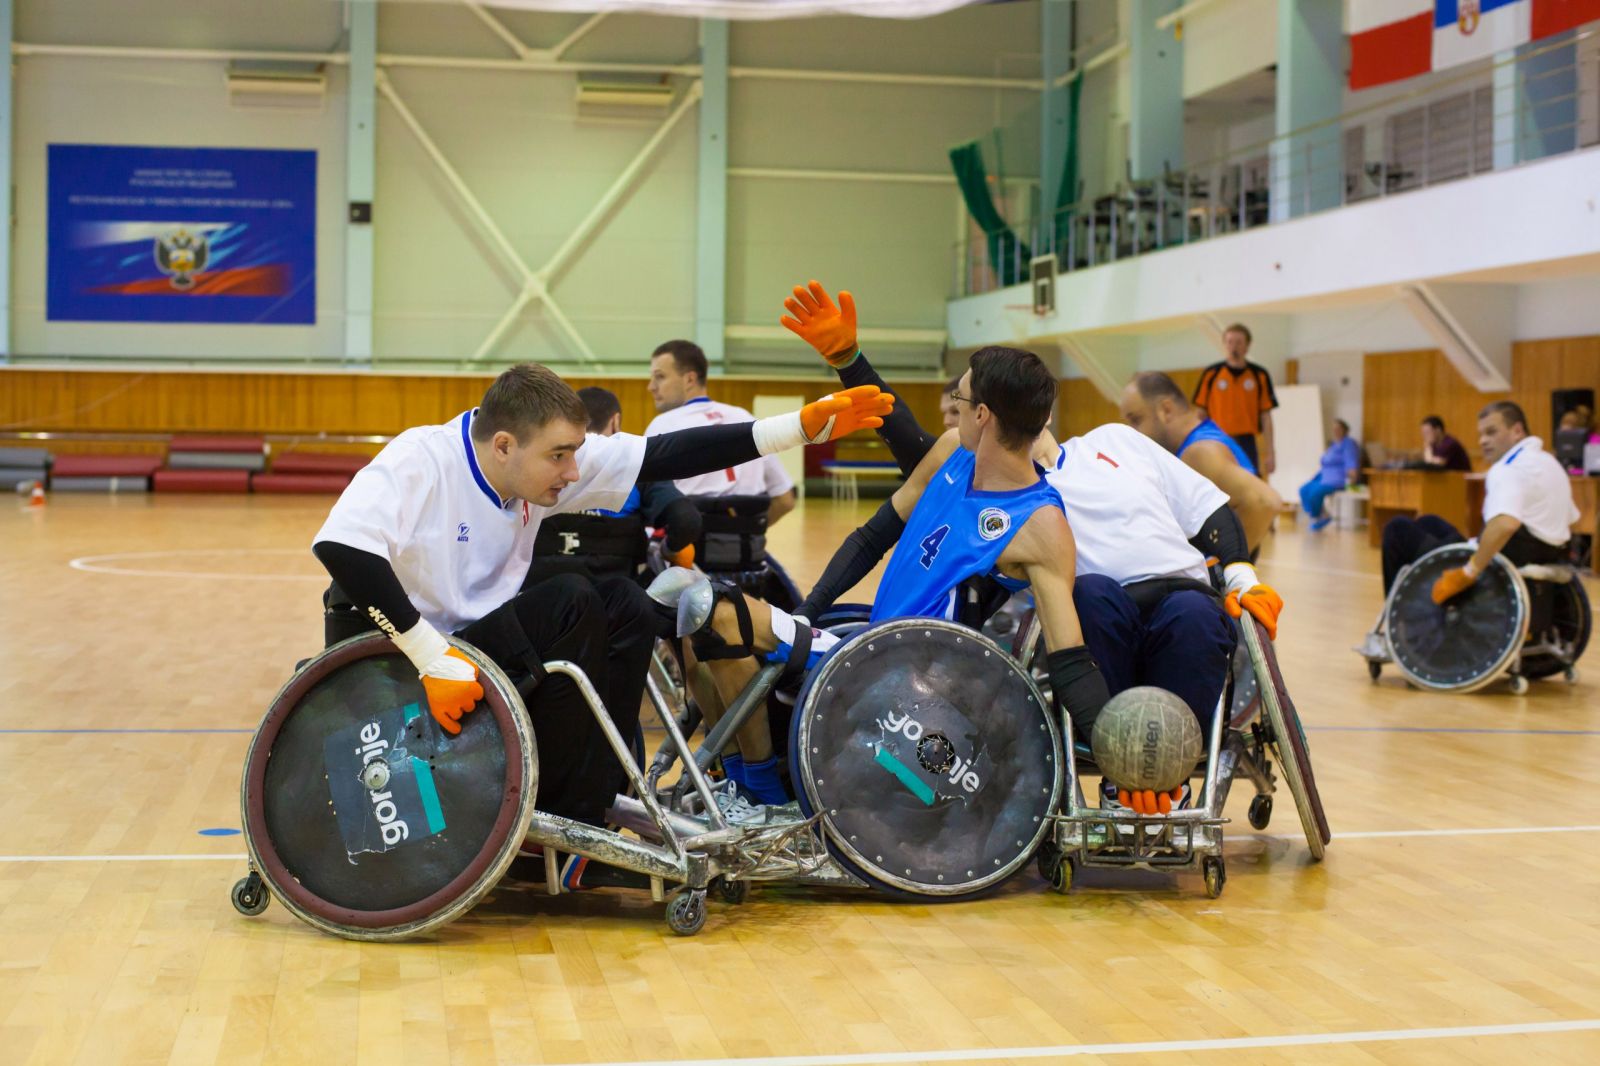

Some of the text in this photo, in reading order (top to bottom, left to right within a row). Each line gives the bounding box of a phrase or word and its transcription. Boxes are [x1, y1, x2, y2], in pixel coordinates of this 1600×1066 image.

[919, 523, 950, 570] 4
[1142, 720, 1160, 780] molten
[355, 721, 409, 845] gornje
